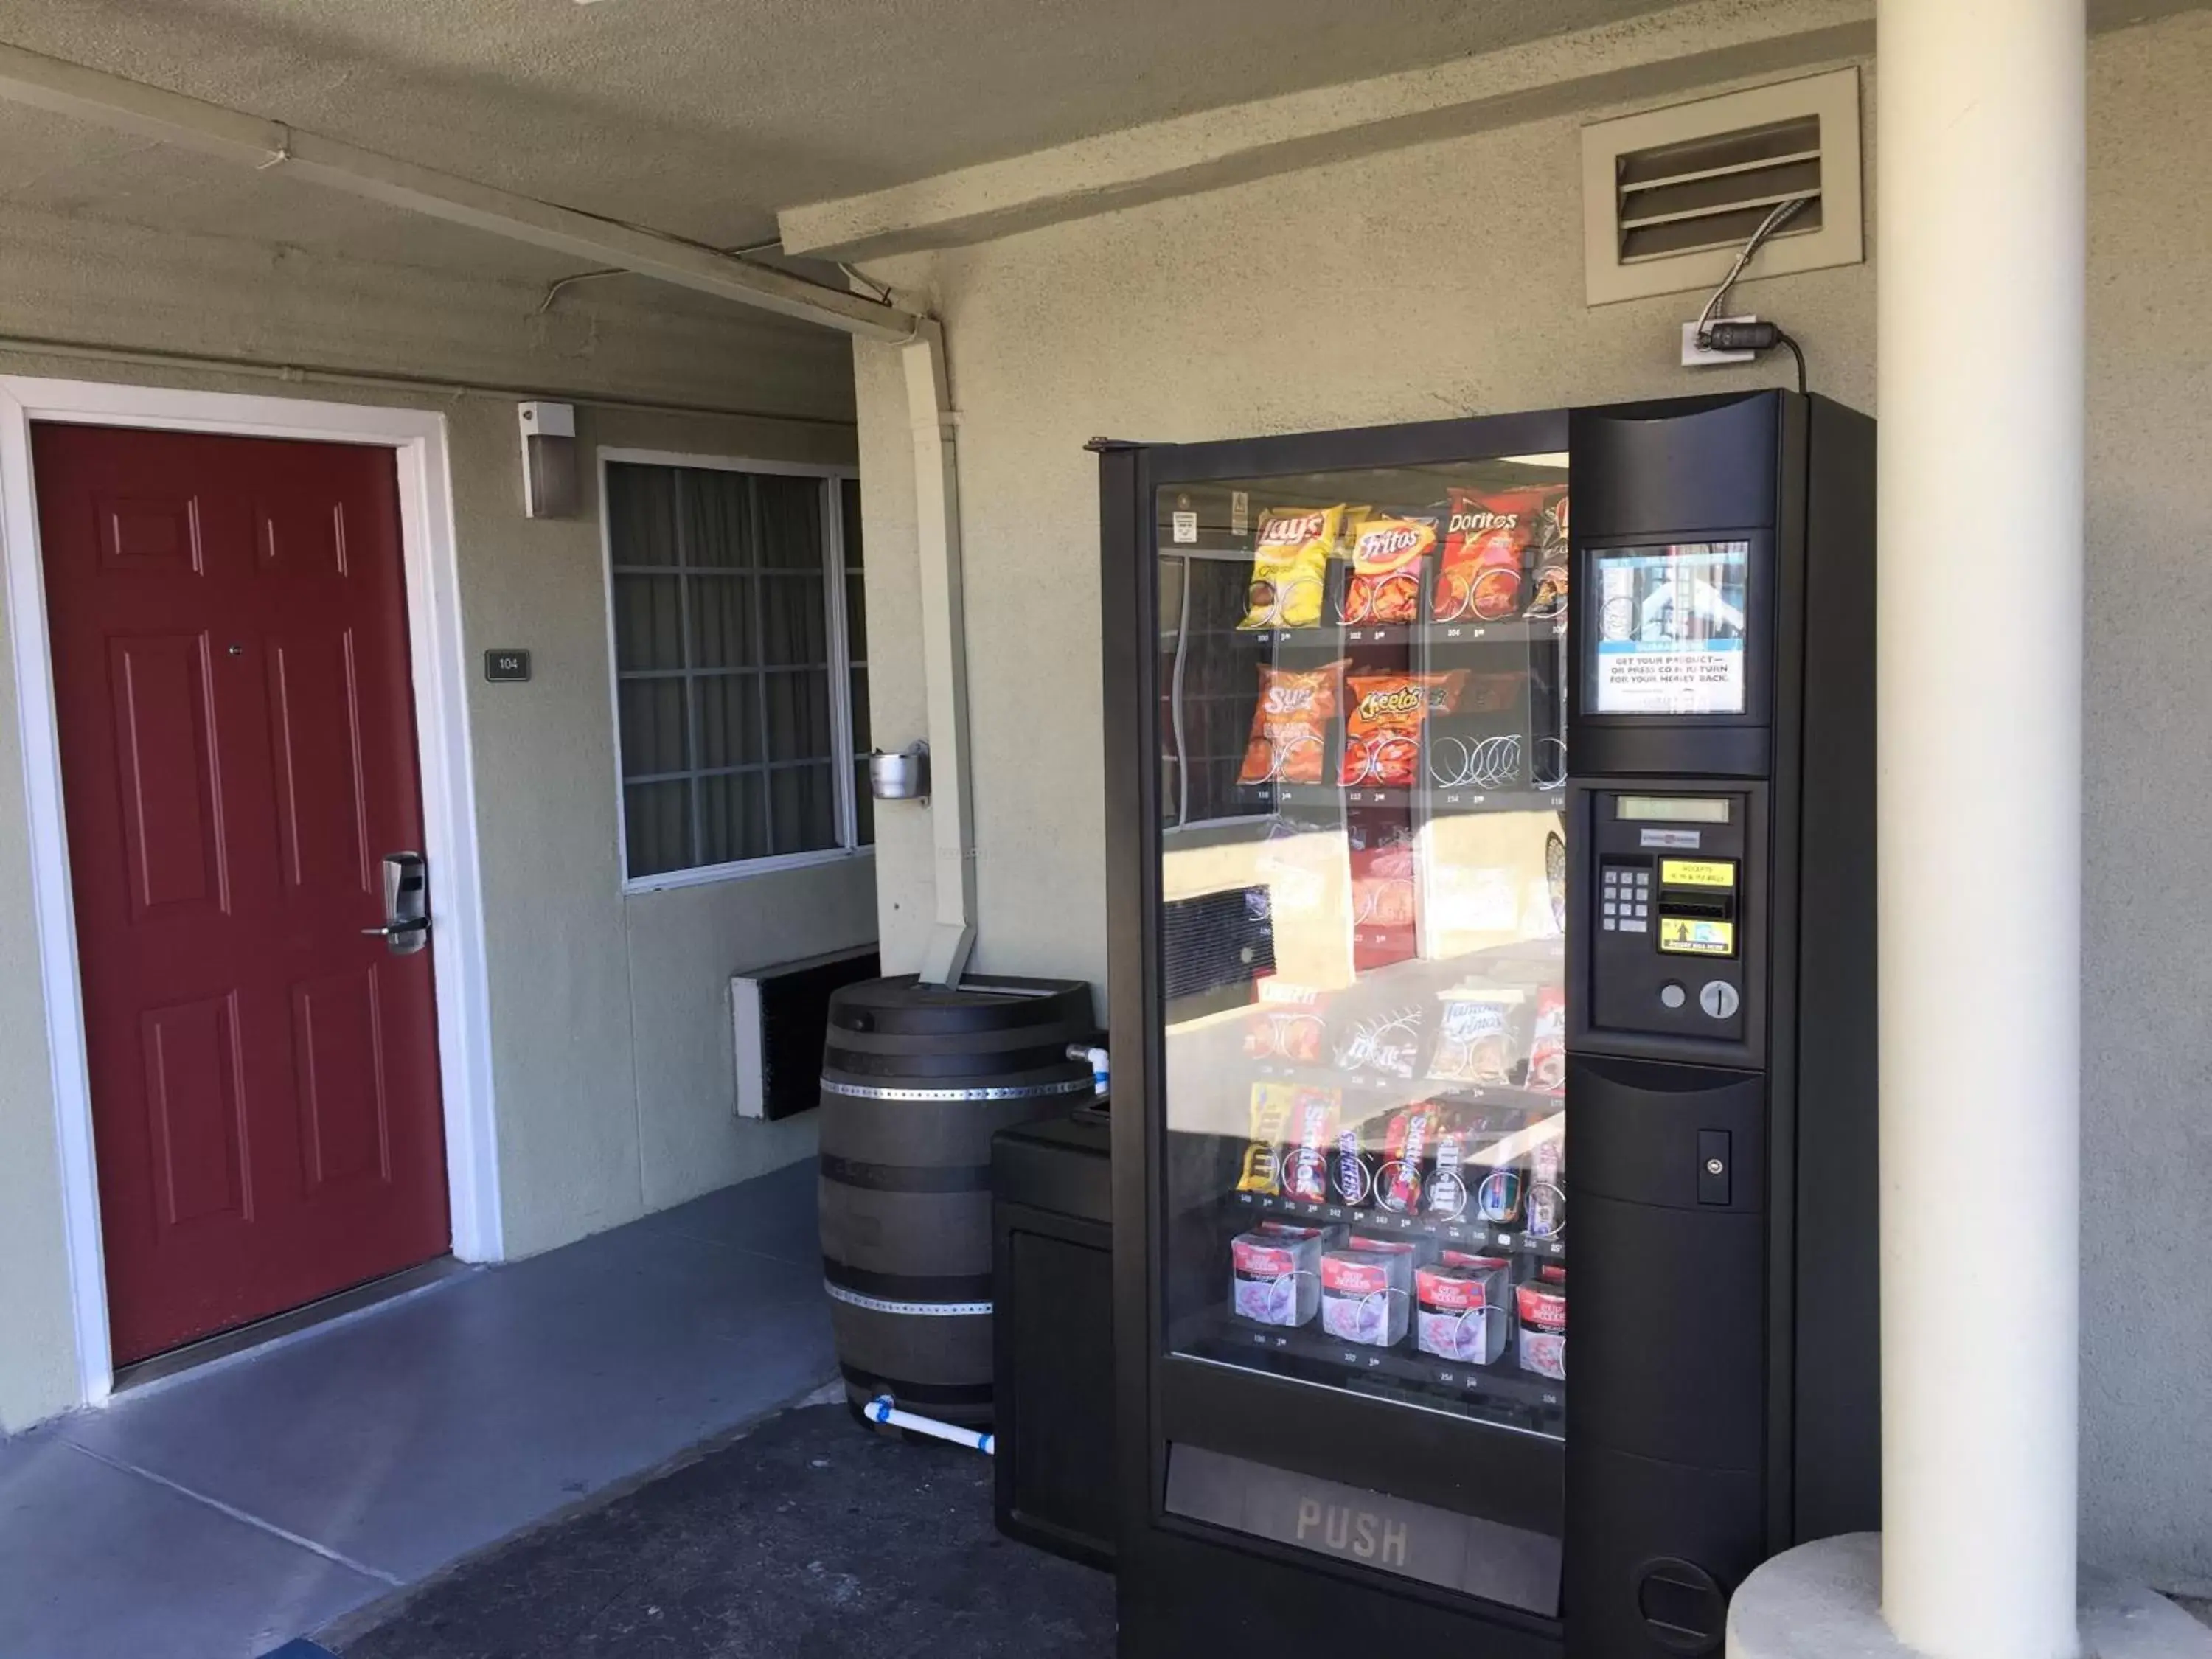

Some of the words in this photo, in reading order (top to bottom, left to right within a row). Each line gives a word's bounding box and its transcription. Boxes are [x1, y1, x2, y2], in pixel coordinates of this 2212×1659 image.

[1449, 513, 1518, 532] Doritos
[1360, 529, 1419, 560] Fritos
[499, 658, 518, 669] 104
[1359, 686, 1422, 720] Cheetos
[1340, 1132, 1359, 1200] SNICKERS
[1296, 1496, 1407, 1567] PUSH
